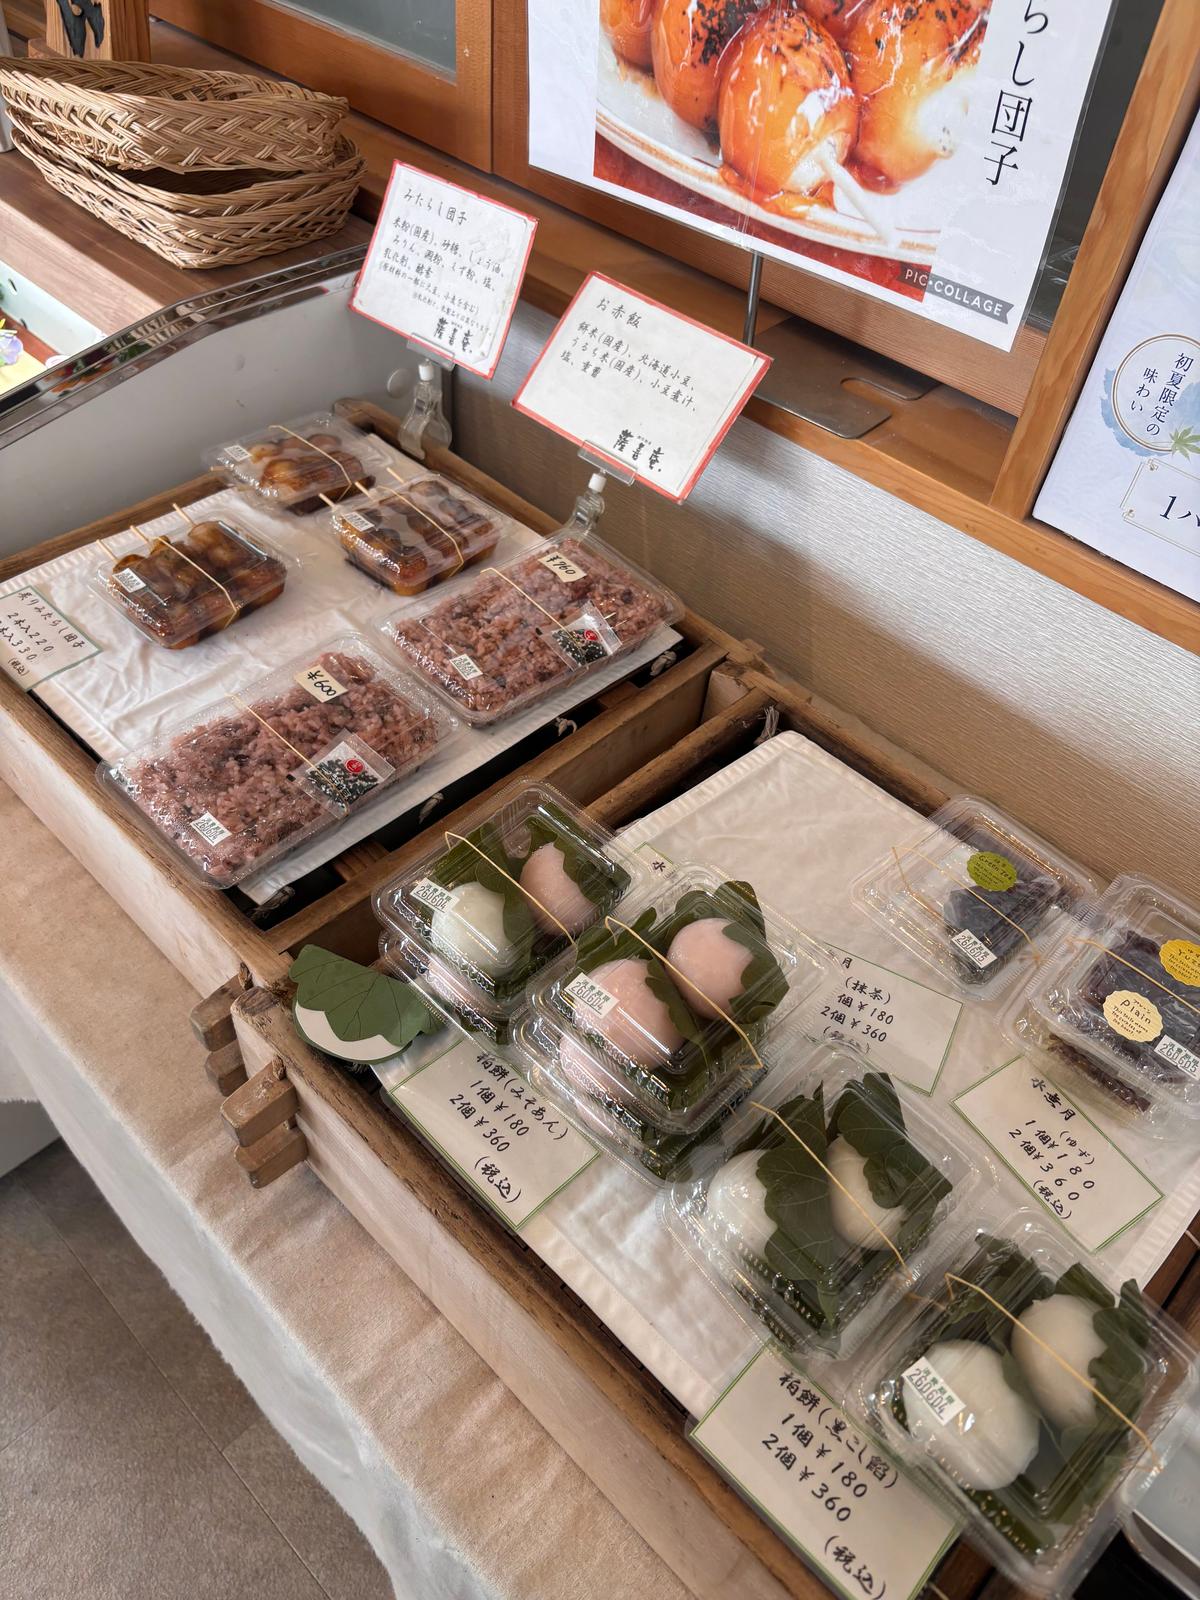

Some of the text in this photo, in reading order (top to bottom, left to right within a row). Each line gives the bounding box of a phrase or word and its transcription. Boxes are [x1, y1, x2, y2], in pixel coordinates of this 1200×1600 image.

[404, 188, 468, 226] みたらし団子
[596, 298, 641, 330] お赤飯
[1130, 368, 1158, 412] 味わい
[1146, 353, 1194, 435] 初夏限定の
[546, 555, 576, 575] ¥760
[0, 621, 37, 661] 本入330
[308, 670, 336, 696] ¥600
[417, 887, 448, 910] 260604
[842, 957, 852, 969] 月
[958, 935, 988, 961] 260605
[569, 982, 603, 1010] 260604
[846, 976, 891, 1005] (抹茶)
[820, 1006, 888, 1042] 2個¥360
[1120, 998, 1151, 1025] Plain
[1160, 1044, 1199, 1073] 260605
[470, 1080, 529, 1137] 1個¥180
[477, 1053, 568, 1140] 柏餅(みそあん)
[1031, 1077, 1076, 1120] 水無月
[450, 1094, 510, 1152] 2個¥360
[1060, 1130, 1095, 1164] (ゆず)
[474, 1155, 522, 1203] (税込)
[1033, 1180, 1072, 1220] (税込)
[910, 1368, 946, 1414] 260604
[781, 1413, 868, 1498] 1個¥180
[762, 1433, 852, 1522] 2個¥360
[824, 1535, 886, 1600] (税込)
